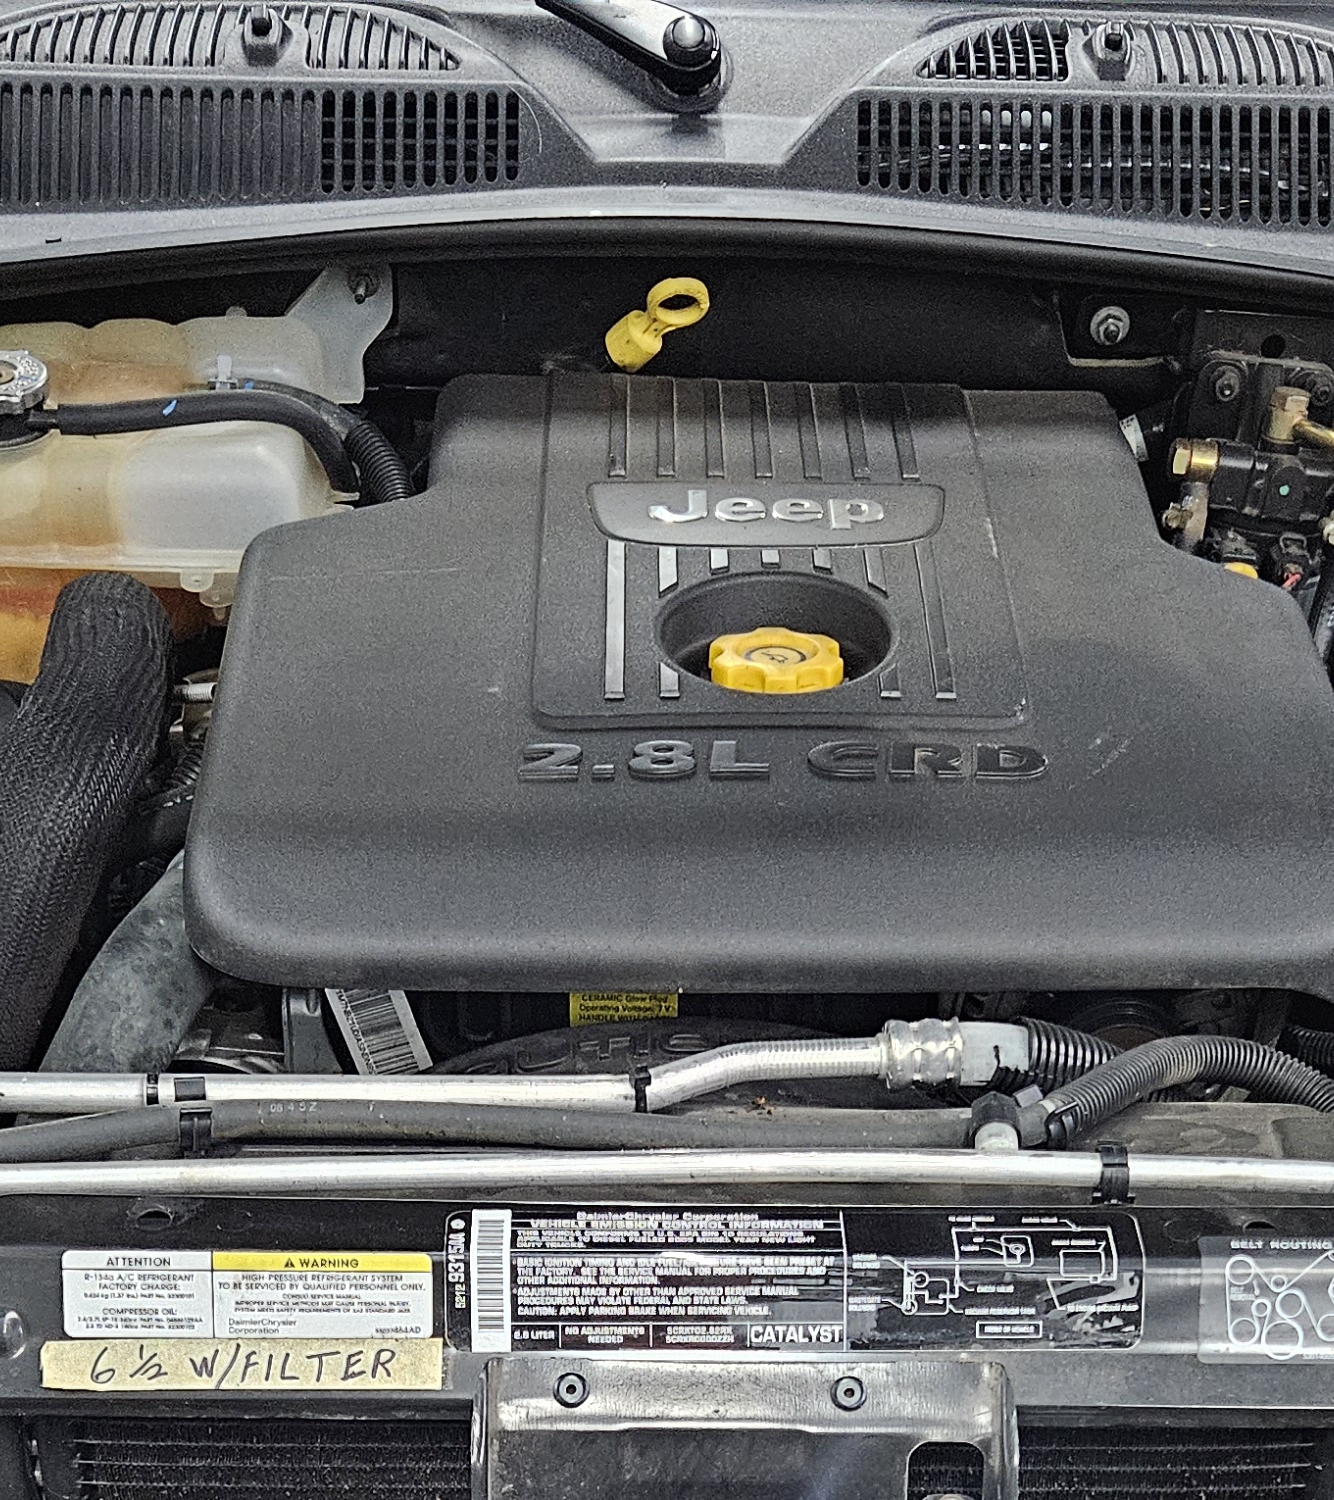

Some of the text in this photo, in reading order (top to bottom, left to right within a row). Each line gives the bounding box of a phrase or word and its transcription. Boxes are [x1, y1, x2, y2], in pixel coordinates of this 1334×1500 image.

[647, 489, 884, 530] Jeep
[518, 740, 1049, 780] 2.8L CRD
[661, 1220, 725, 1229] CONTROL
[729, 1220, 823, 1229] INFORMATION
[1230, 1240, 1333, 1249] BELT ROUTING
[106, 1257, 171, 1267] ATTENTION
[299, 1259, 359, 1269] WARNING
[656, 1267, 692, 1275] MANUAL
[695, 1267, 711, 1275] FOR
[269, 1274, 308, 1282] PRESSURE
[311, 1274, 369, 1282] REFRIGERANT
[371, 1274, 403, 1282] SYSTEM
[219, 1282, 426, 1291] TO BE SERVICED BY QUALIFIED PERSONNEL ONLY.
[518, 1287, 580, 1296] ADJUSTMENTS
[623, 1287, 651, 1296] OTHER
[653, 1287, 676, 1296] THAN
[678, 1287, 723, 1296] APPROVED
[725, 1287, 761, 1295] SERVICE
[762, 1286, 799, 1295] MANUAL
[576, 1297, 595, 1305] MAY
[598, 1297, 631, 1305] VIOLATE
[673, 1296, 692, 1305] AND
[693, 1296, 718, 1305] STATE
[518, 1307, 557, 1316] CAUTION:
[559, 1307, 586, 1315] APPLY
[589, 1307, 626, 1315] PARKING
[629, 1306, 656, 1315] BRAKE
[659, 1306, 685, 1315] WHEN
[688, 1306, 733, 1315] SERVICING
[229, 1319, 297, 1327] DaimlerChrysler
[531, 1330, 555, 1340] LITER
[581, 1327, 645, 1335] ADJUSTMENTS
[751, 1326, 842, 1343] CATALYST
[90, 1346, 113, 1384] 6
